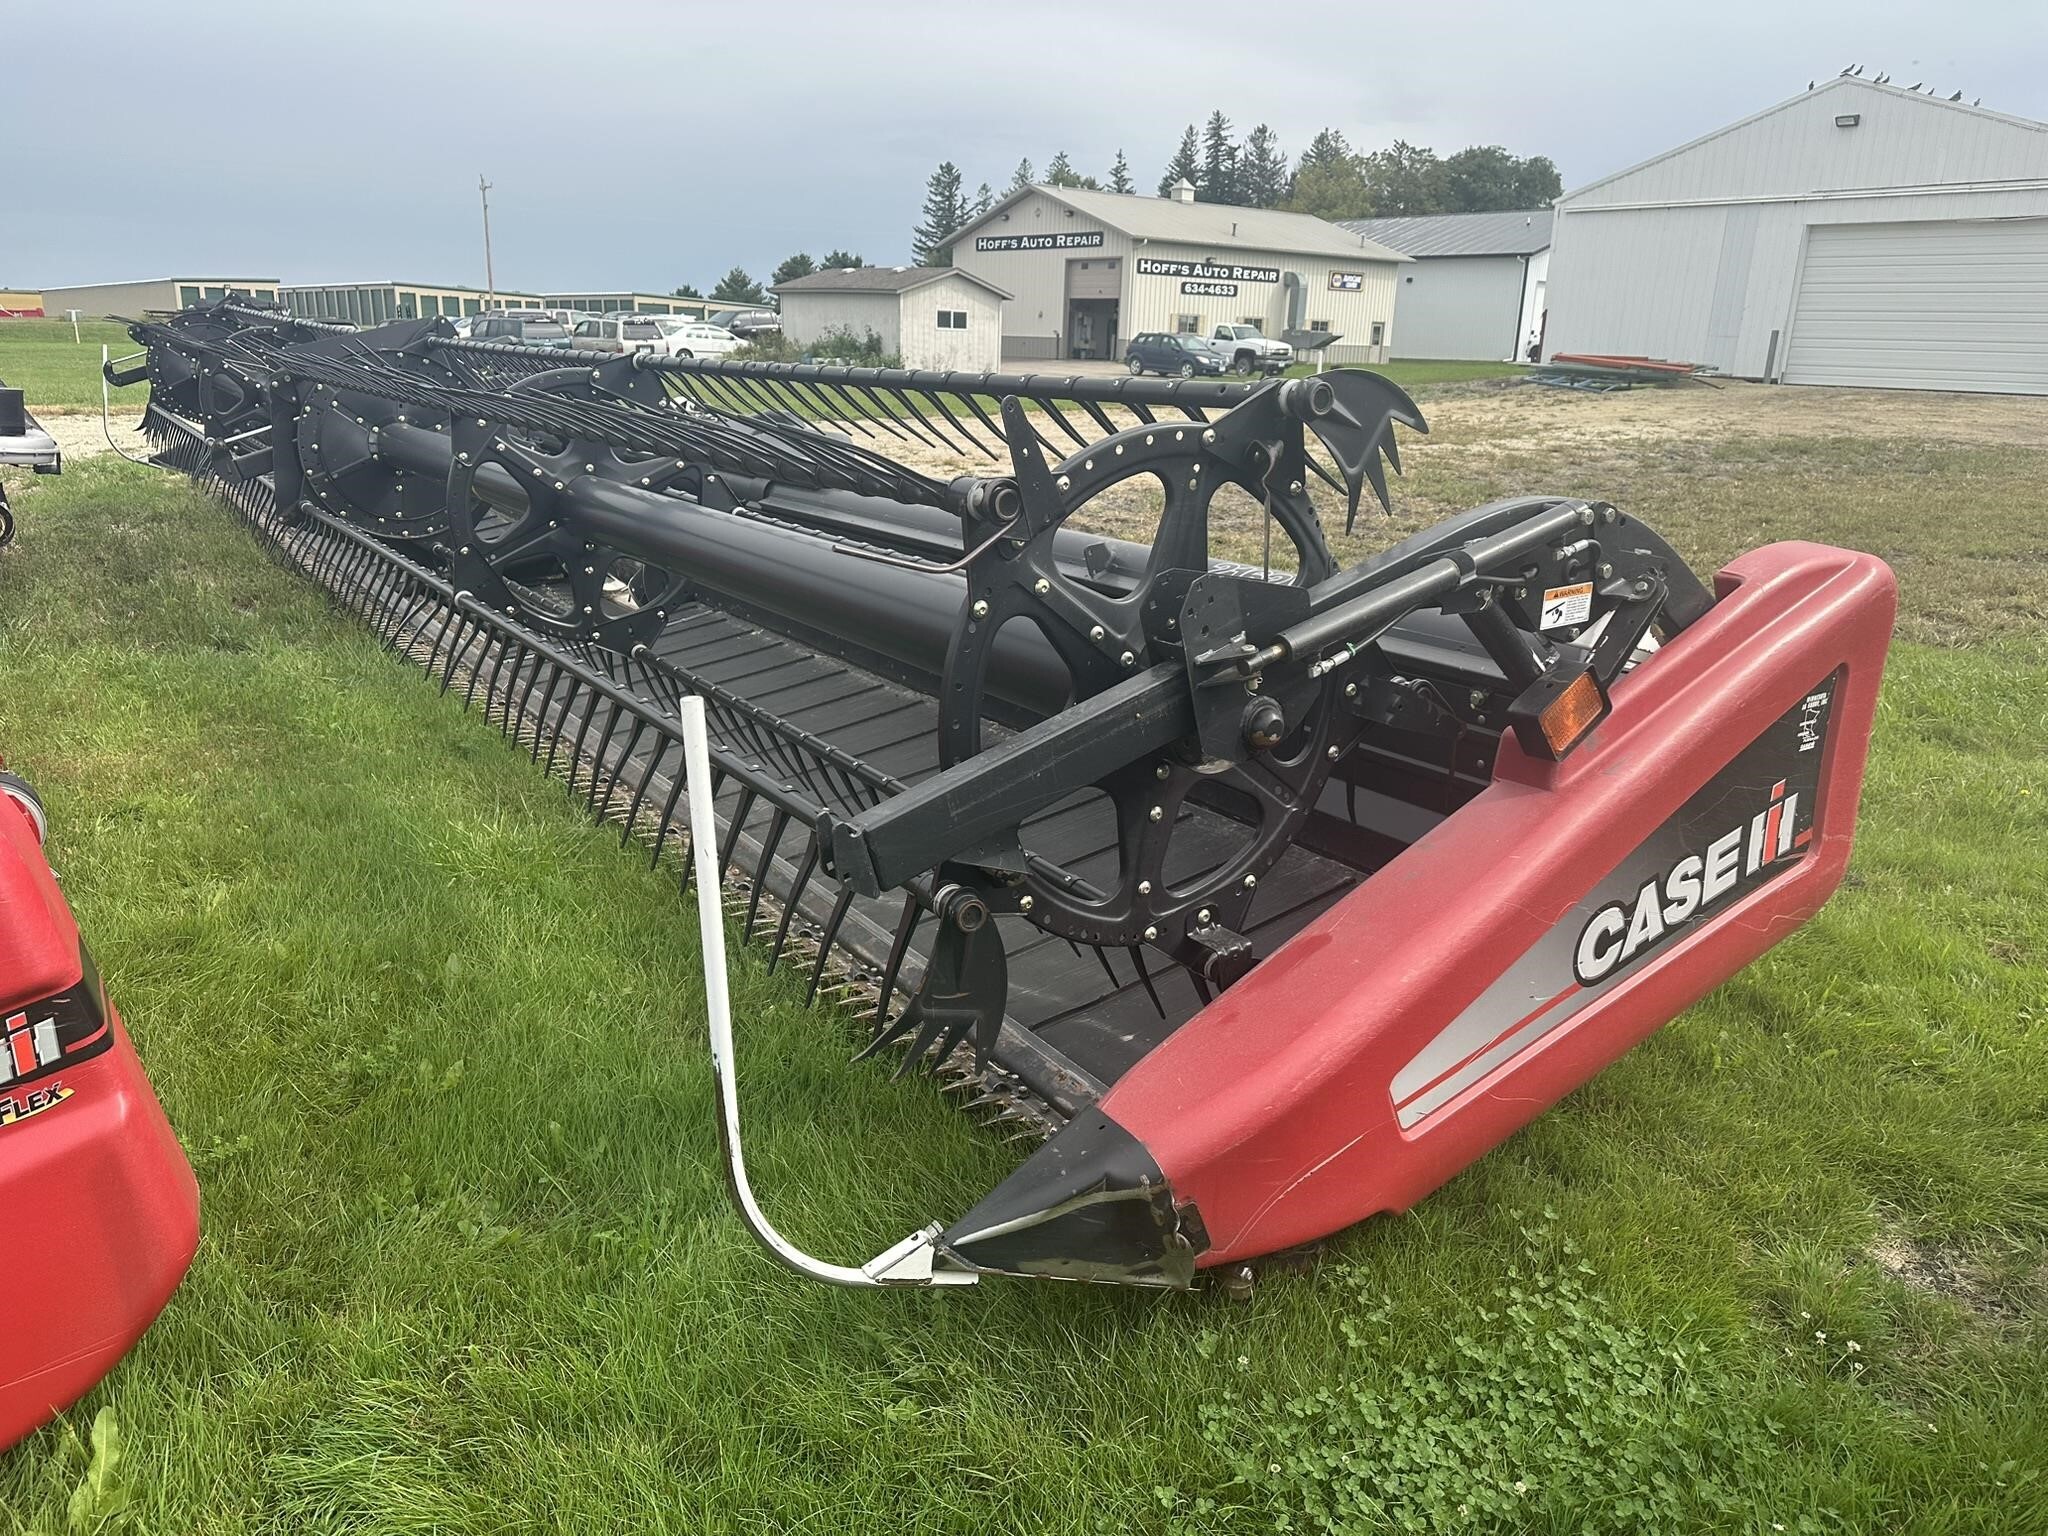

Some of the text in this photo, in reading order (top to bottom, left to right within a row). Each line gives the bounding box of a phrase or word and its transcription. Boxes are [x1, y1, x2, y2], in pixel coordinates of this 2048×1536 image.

[1020, 236, 1053, 248] AUTO
[1056, 234, 1101, 247] REPAIR
[1139, 260, 1278, 281] HOFF'S AUTO REPAIR
[1184, 283, 1235, 296] 634-4633
[1576, 825, 1744, 980] CASE
